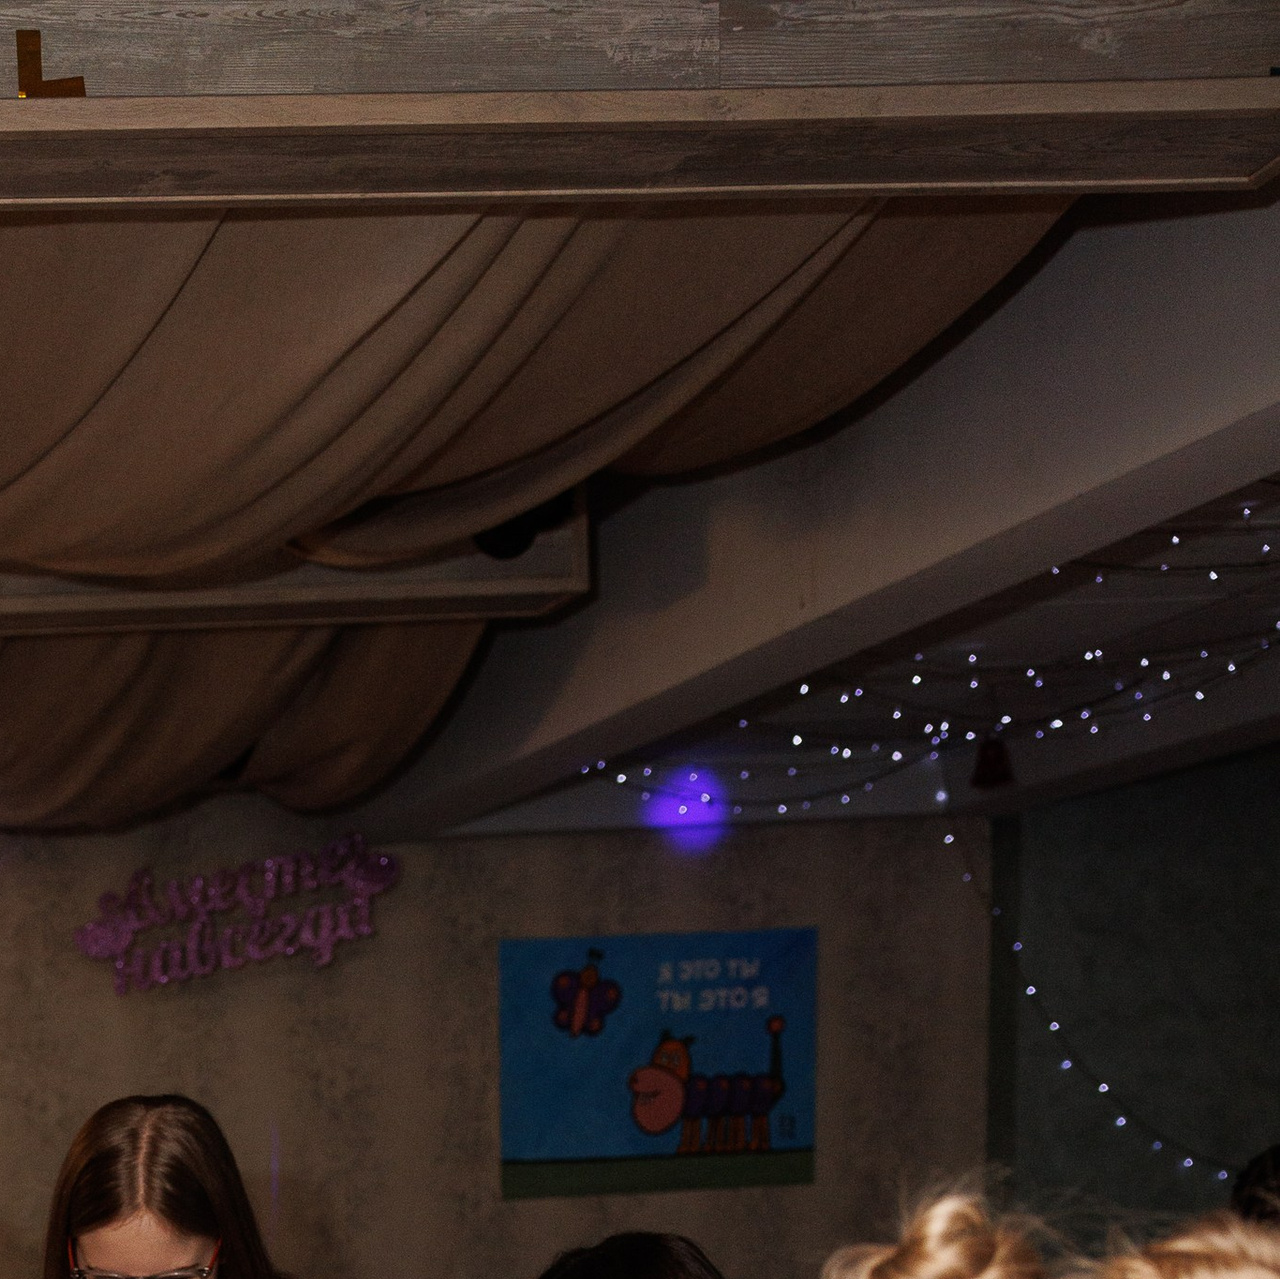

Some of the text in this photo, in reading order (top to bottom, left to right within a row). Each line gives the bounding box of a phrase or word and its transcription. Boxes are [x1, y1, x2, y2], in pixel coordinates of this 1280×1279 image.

[678, 958, 721, 981] ЭТО
[726, 957, 761, 979] ТЫ
[657, 989, 691, 1012] ТЫ
[698, 986, 748, 1011] ЭТО
